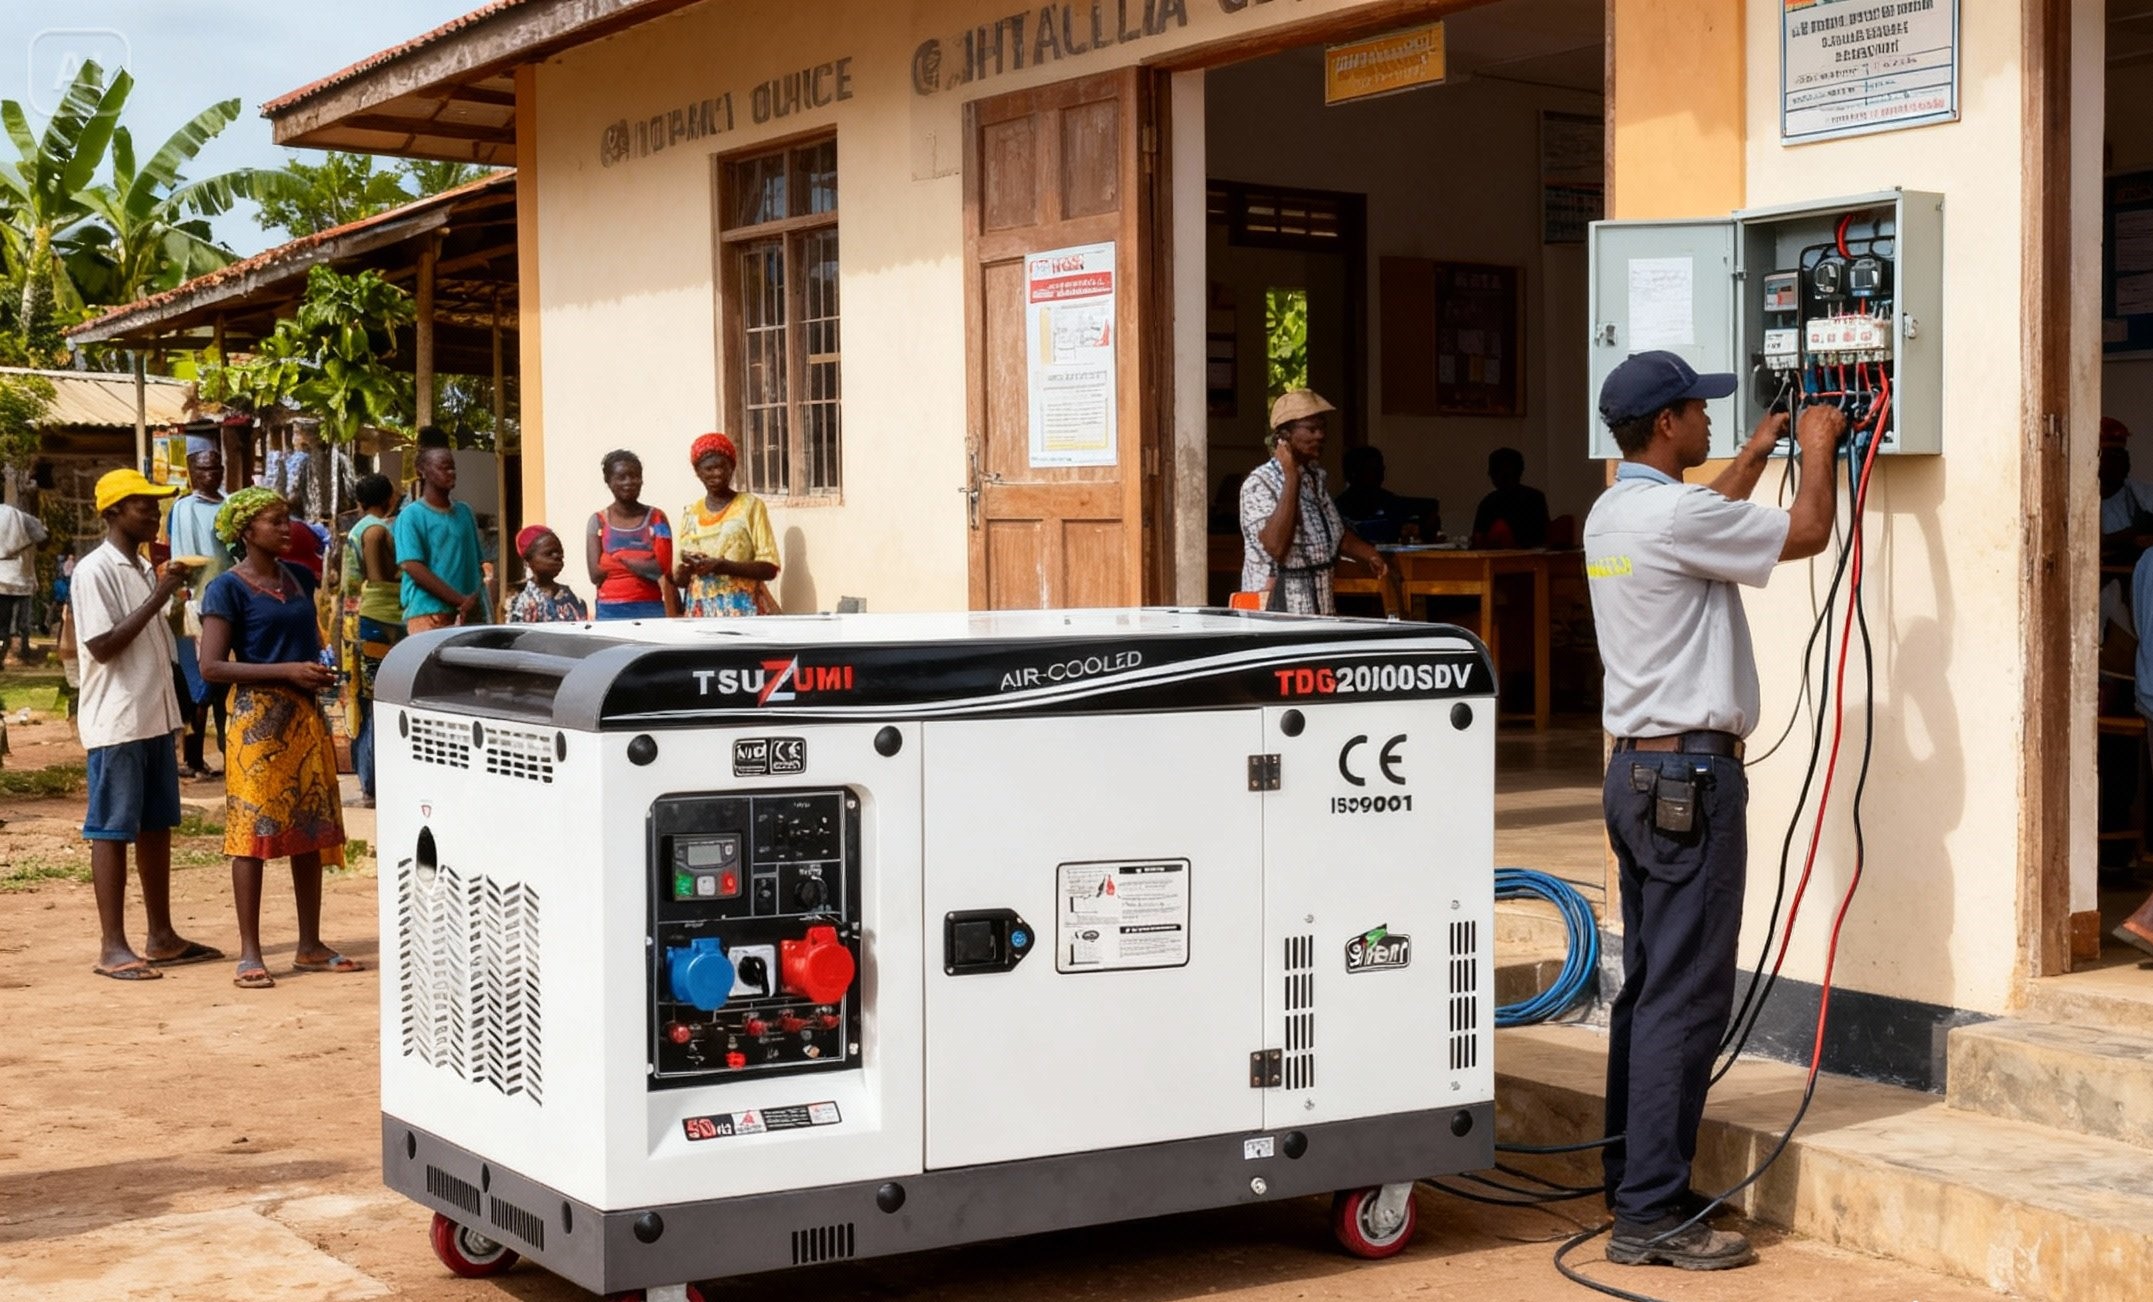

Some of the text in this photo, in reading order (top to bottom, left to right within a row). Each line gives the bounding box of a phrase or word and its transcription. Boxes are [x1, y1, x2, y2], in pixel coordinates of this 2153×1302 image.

[692, 653, 853, 708] TSUZUMI
[1001, 651, 1142, 691] AIR-COOLED
[1338, 733, 1407, 787] CE
